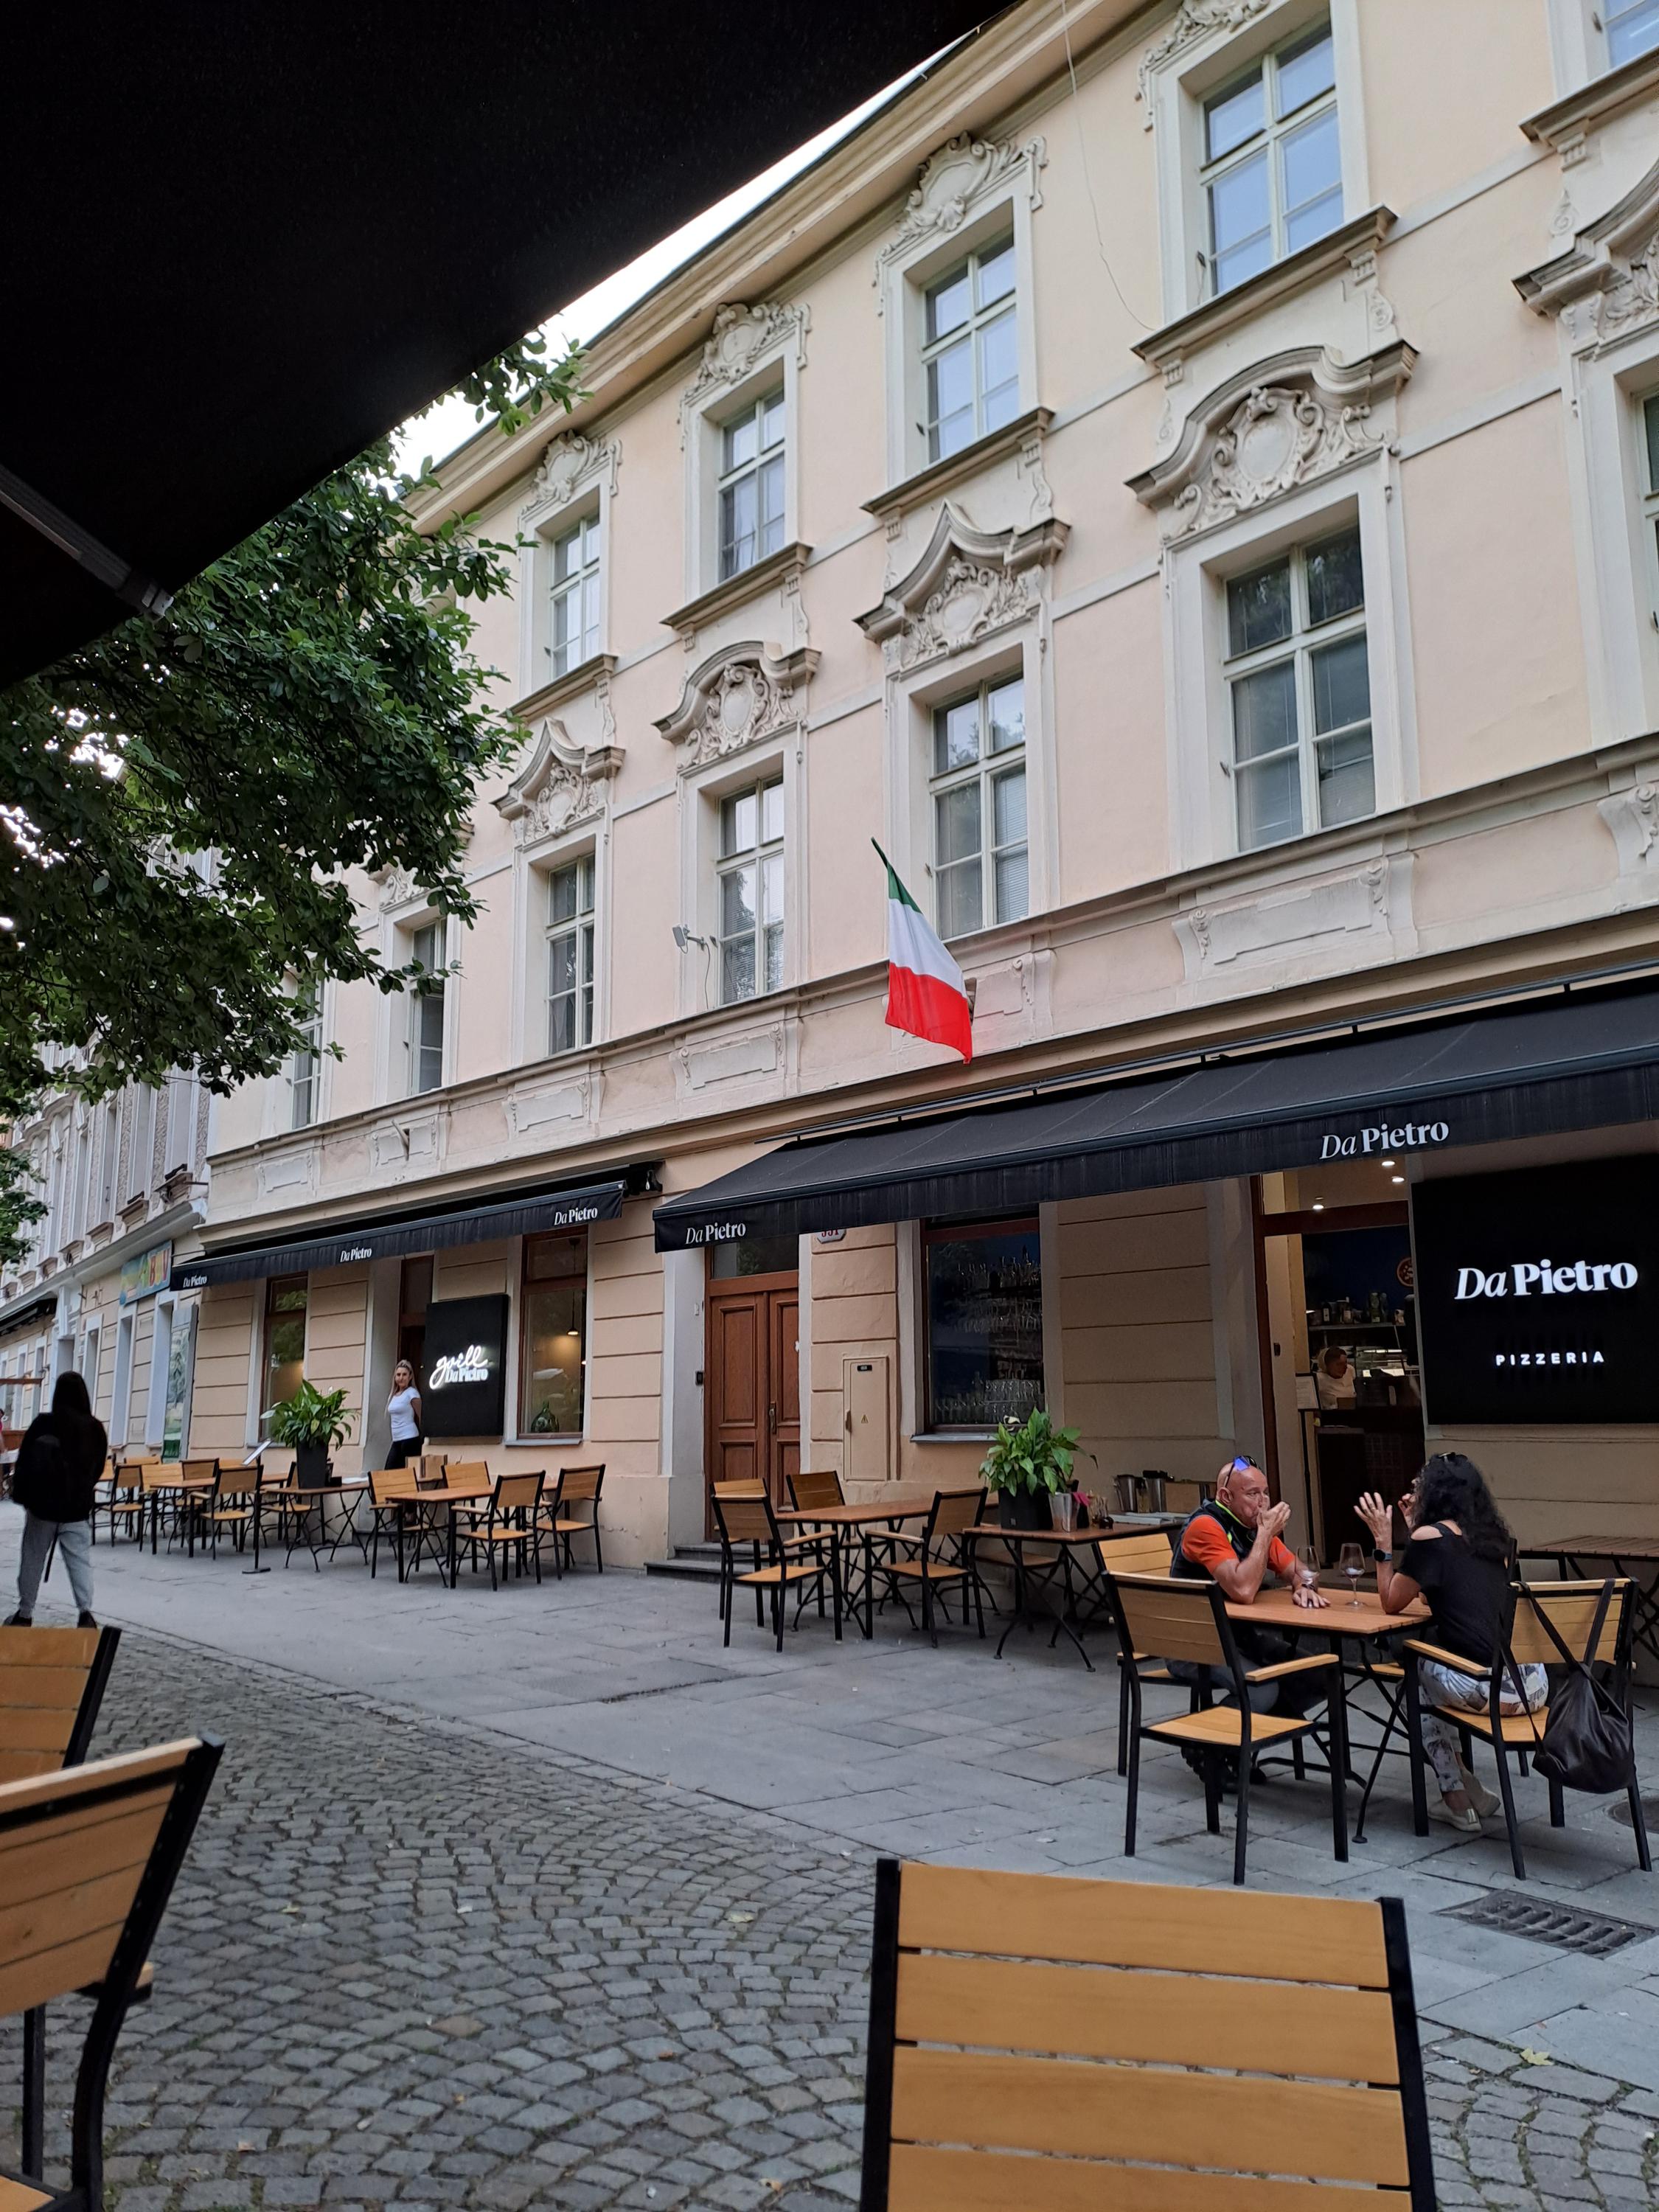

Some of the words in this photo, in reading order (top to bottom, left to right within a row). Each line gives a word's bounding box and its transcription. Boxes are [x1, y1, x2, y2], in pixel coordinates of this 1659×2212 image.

[1319, 1134, 1357, 1160] Da
[1360, 1121, 1449, 1153] Pietro
[554, 1211, 567, 1225] Da
[568, 1207, 598, 1223] Pietro
[685, 1227, 703, 1245] Da
[705, 1222, 746, 1242] Pietro
[340, 1250, 350, 1262] Da
[350, 1246, 372, 1261] Pietro
[191, 1275, 207, 1287] Pietro
[1454, 1267, 1508, 1299] Da
[1511, 1259, 1638, 1295] Pietro
[429, 1344, 488, 1390] grill
[1495, 1351, 1604, 1366] PIZZERIA
[445, 1369, 458, 1382] Da
[459, 1366, 488, 1382] Pietro
